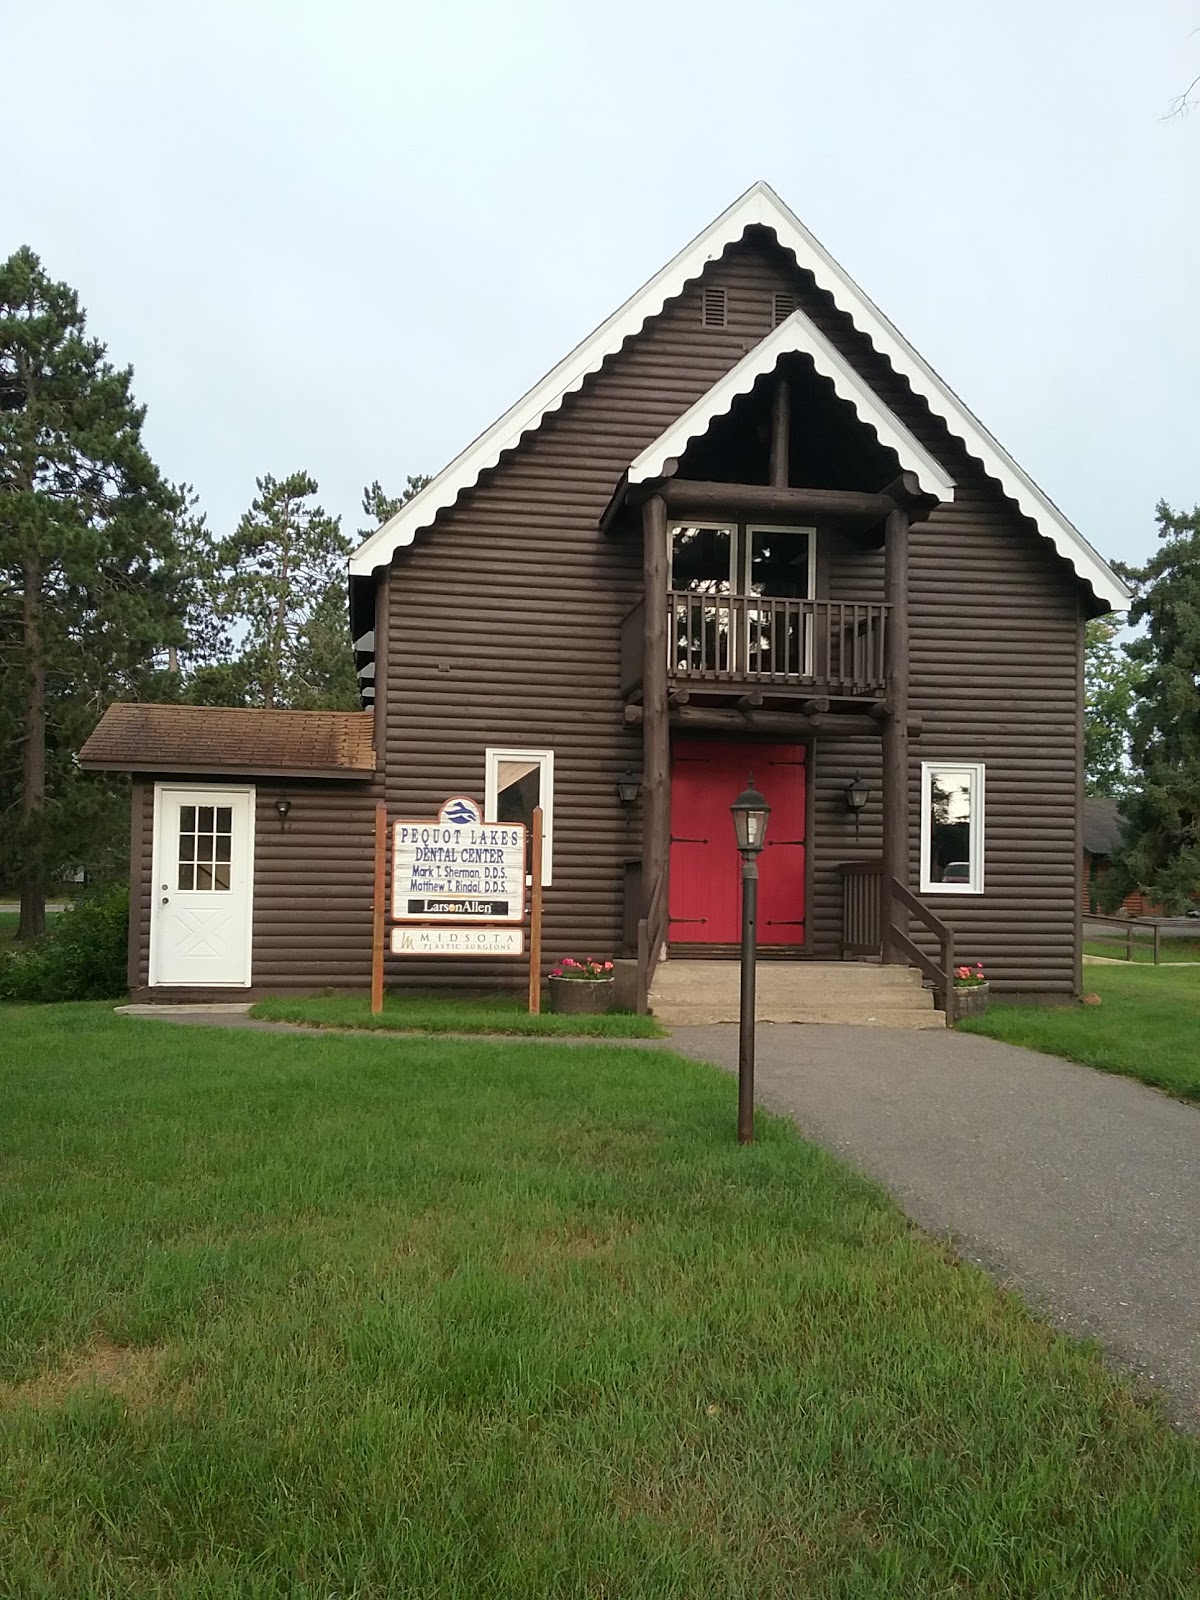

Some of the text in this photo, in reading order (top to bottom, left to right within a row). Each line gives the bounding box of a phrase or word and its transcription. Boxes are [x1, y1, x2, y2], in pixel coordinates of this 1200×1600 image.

[401, 828, 518, 848] PEQUOT LAKES
[415, 847, 504, 863] DENTAL CENTER
[412, 865, 434, 878] Mark
[437, 866, 442, 878] T.
[484, 867, 508, 879] D.D.S.
[410, 879, 445, 892] Matthew
[448, 880, 453, 892] T.
[485, 881, 508, 893] D.D.S.
[423, 900, 492, 914] LarsonAllen
[420, 933, 514, 943] MIDSOTA
